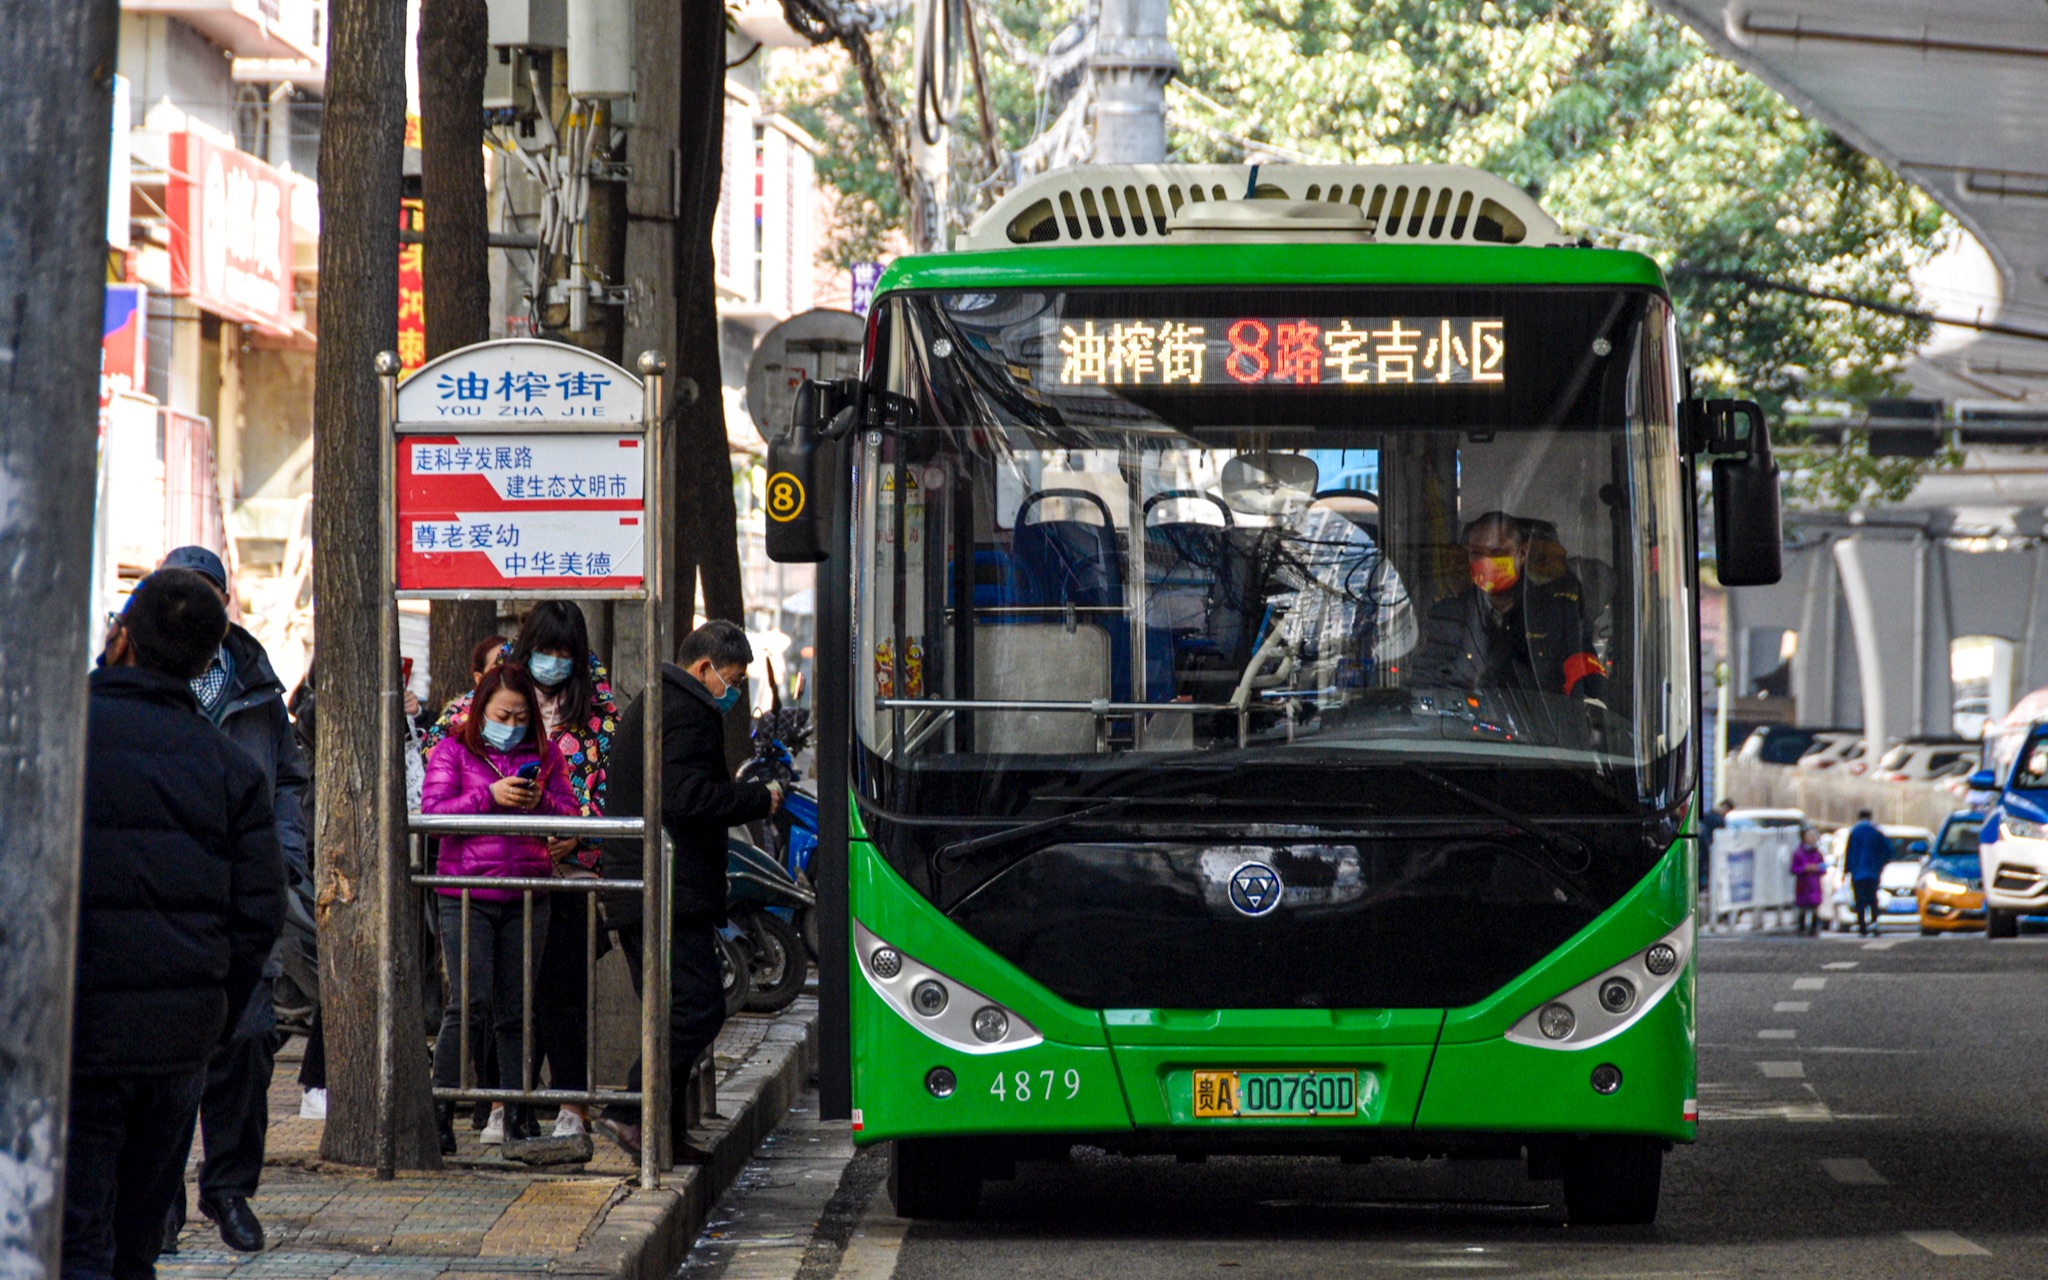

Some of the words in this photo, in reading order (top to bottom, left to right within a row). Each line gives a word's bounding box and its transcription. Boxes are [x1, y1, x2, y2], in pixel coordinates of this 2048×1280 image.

[1058, 321, 1206, 384] 油榨街
[1324, 320, 1504, 383] 宅吉小区
[436, 371, 612, 402] 油榨街
[436, 405, 481, 416] YOU
[499, 405, 544, 416] ZHA
[561, 405, 605, 416] JIE
[415, 446, 533, 471] 走科学发展路
[506, 474, 627, 498] 建生态文明市
[773, 483, 794, 511] 8
[414, 523, 520, 548] 尊老爱幼
[505, 551, 612, 576] 中华美德
[990, 1068, 1080, 1101] 4879
[1248, 1077, 1353, 1110] 00760D
